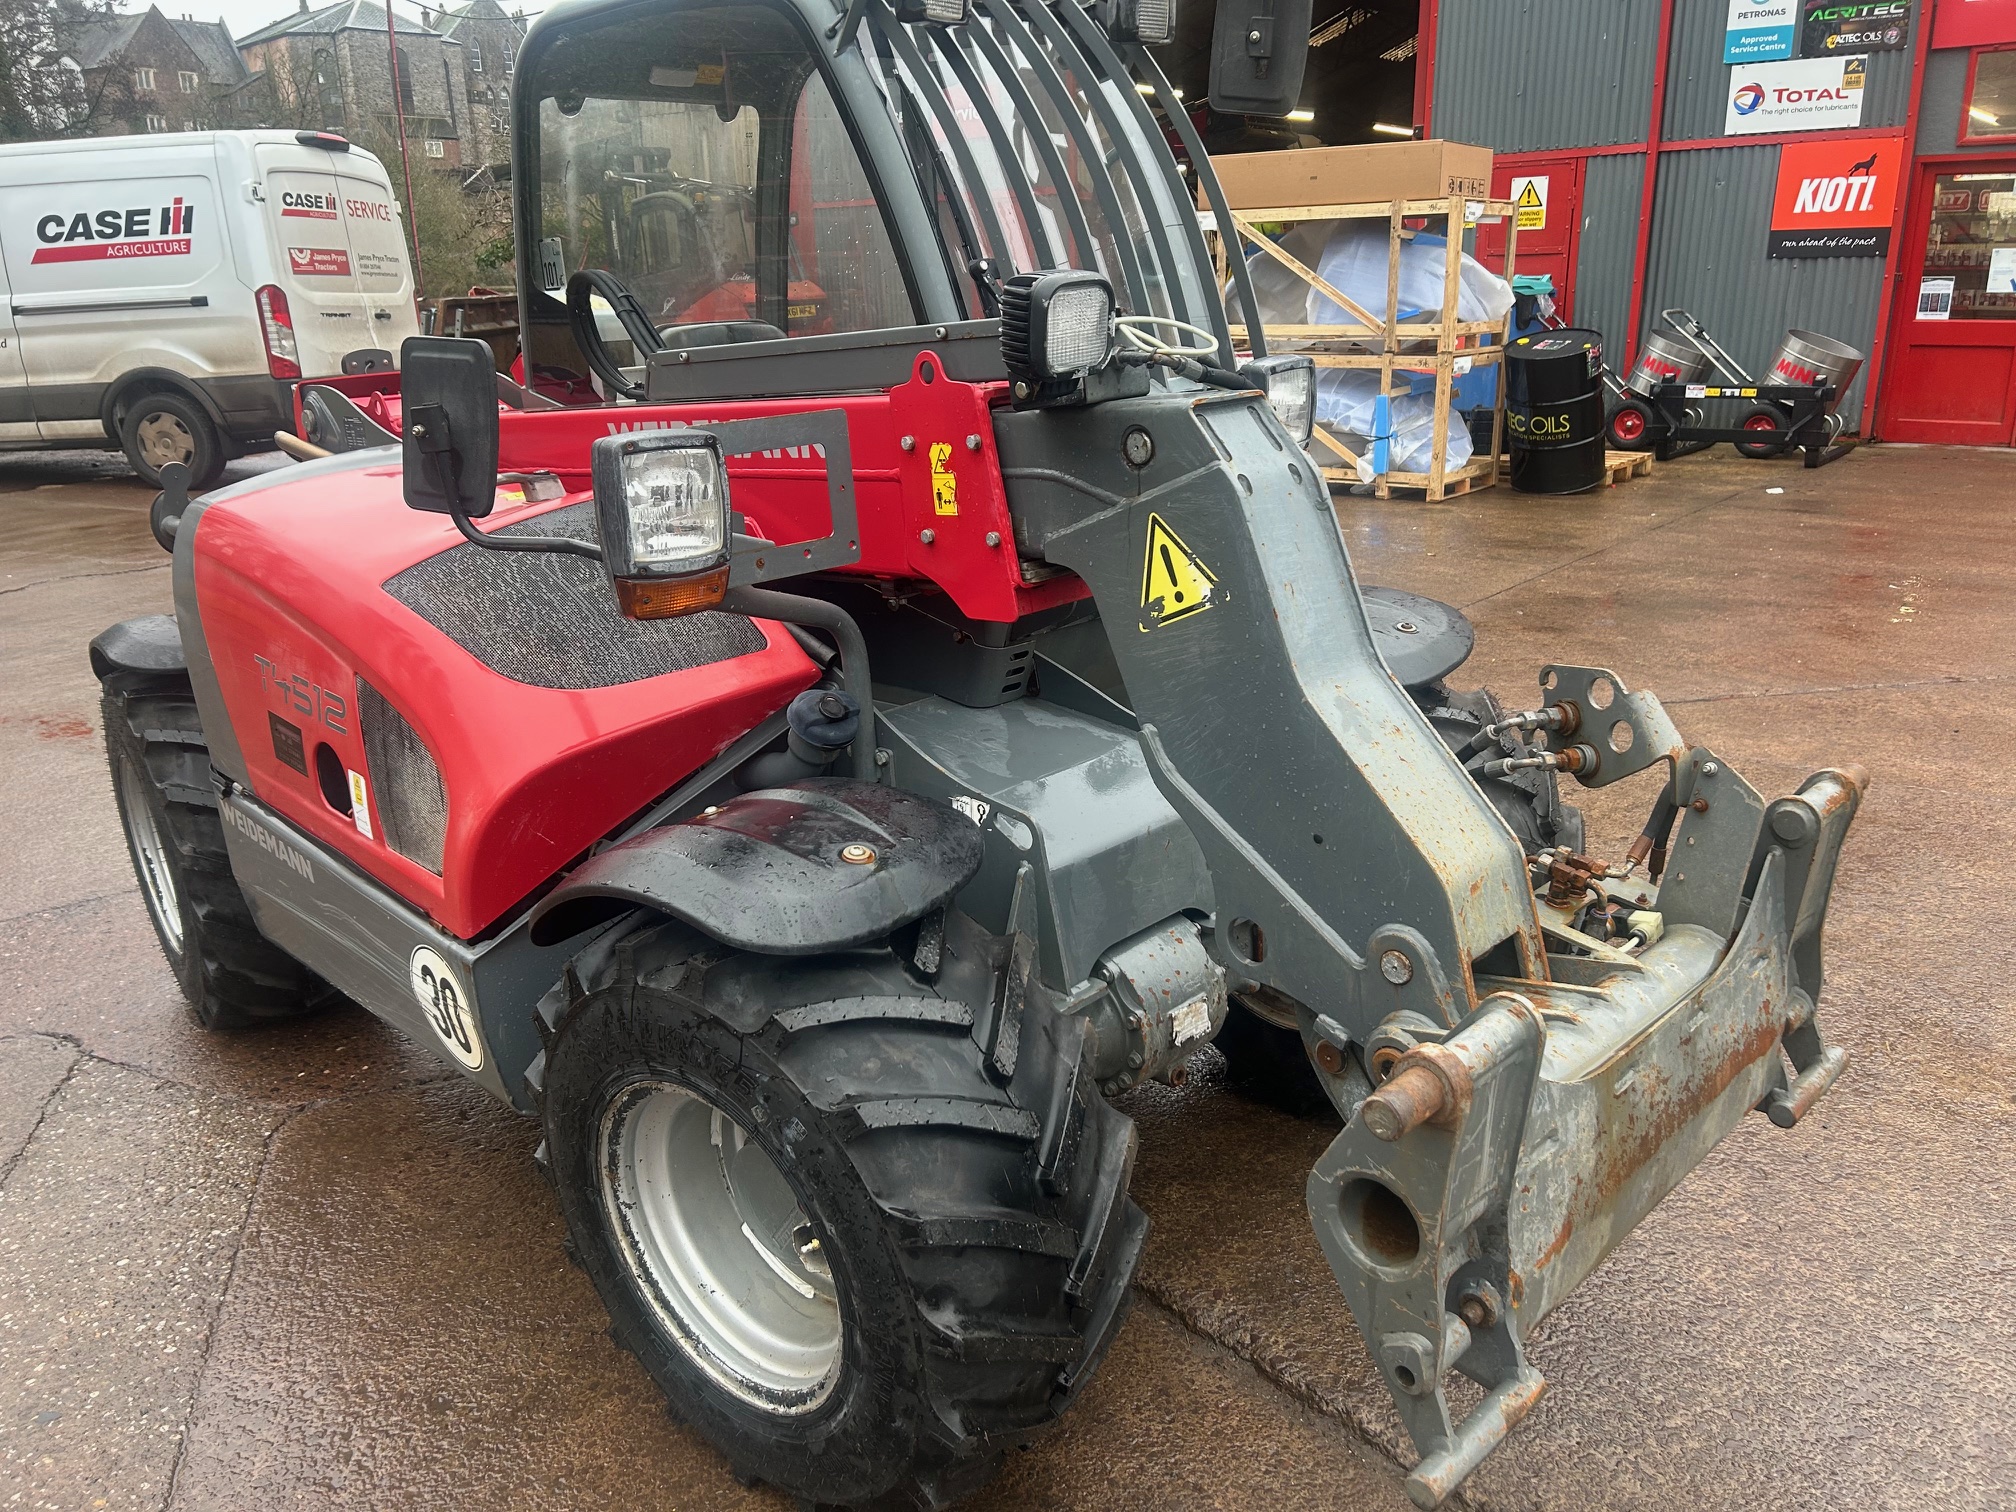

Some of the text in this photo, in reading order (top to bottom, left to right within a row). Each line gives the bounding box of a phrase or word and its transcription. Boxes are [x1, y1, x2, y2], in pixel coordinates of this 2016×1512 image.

[1738, 8, 1786, 19] PETRONAS
[1809, 1, 1906, 21] AGRITEC
[1740, 34, 1778, 44] Approved
[1836, 33, 1861, 43] AZTEC
[1863, 31, 1882, 41] OILS
[1731, 43, 1786, 53] Service Centre
[1773, 87, 1849, 103] TOTAL
[1774, 107, 1789, 116] right
[1790, 106, 1813, 114] choice
[1825, 103, 1858, 111] lubricants
[282, 192, 323, 209] CASE
[1793, 176, 1877, 213] KIOTI
[346, 199, 391, 222] SERVICE
[36, 208, 151, 243] CASE
[106, 241, 188, 256] AGRICULTURE
[1798, 237, 1827, 246] ahead
[1826, 237, 1840, 248] of
[1839, 237, 1851, 246] the
[1851, 237, 1877, 248] pack
[313, 253, 347, 264] James Pryce
[358, 253, 372, 262] James
[314, 263, 337, 271] Tractors
[1506, 410, 1570, 434] TEC OILS
[1529, 433, 1570, 441] SPECIALISTS
[254, 652, 348, 736] T4512
[219, 798, 315, 884] WEIDEMANN
[420, 963, 472, 1055] 30
